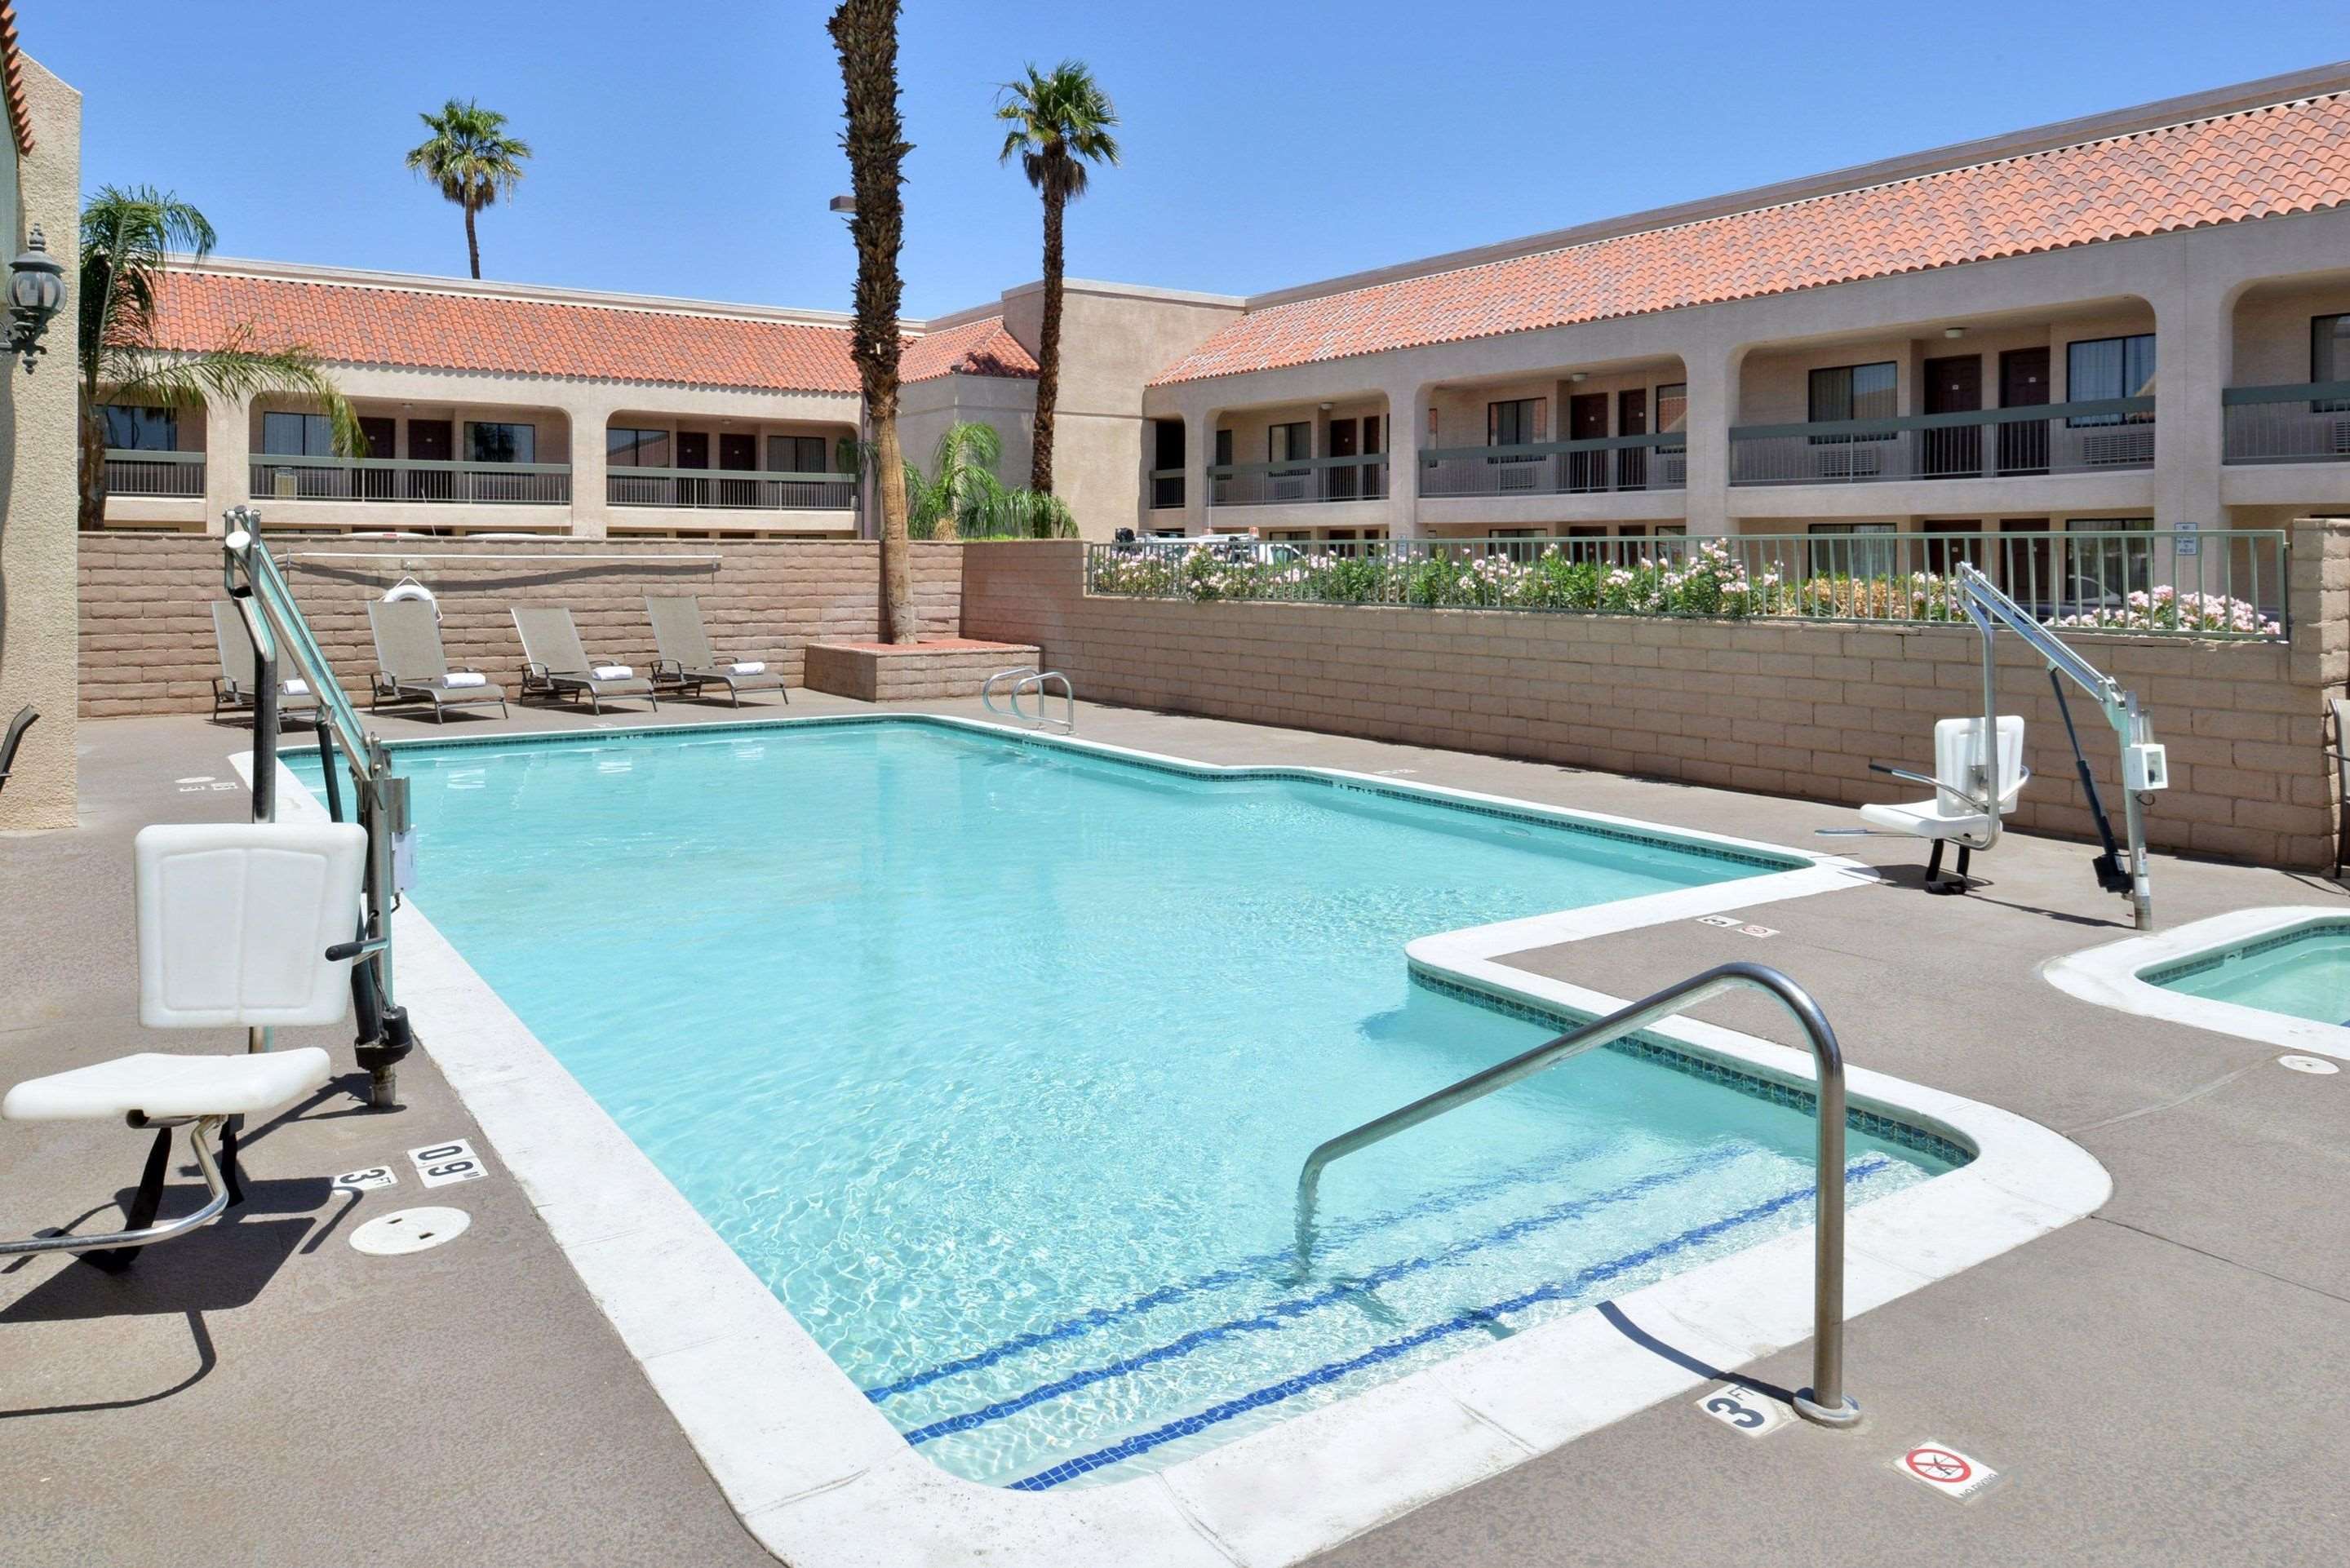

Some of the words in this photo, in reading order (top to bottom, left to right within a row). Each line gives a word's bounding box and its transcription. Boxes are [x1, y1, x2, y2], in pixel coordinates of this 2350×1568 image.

[339, 1168, 386, 1185] 3
[1727, 1385, 1754, 1402] FT
[1706, 1397, 1766, 1428] 3
[1971, 1473, 1998, 1489] DIVING
